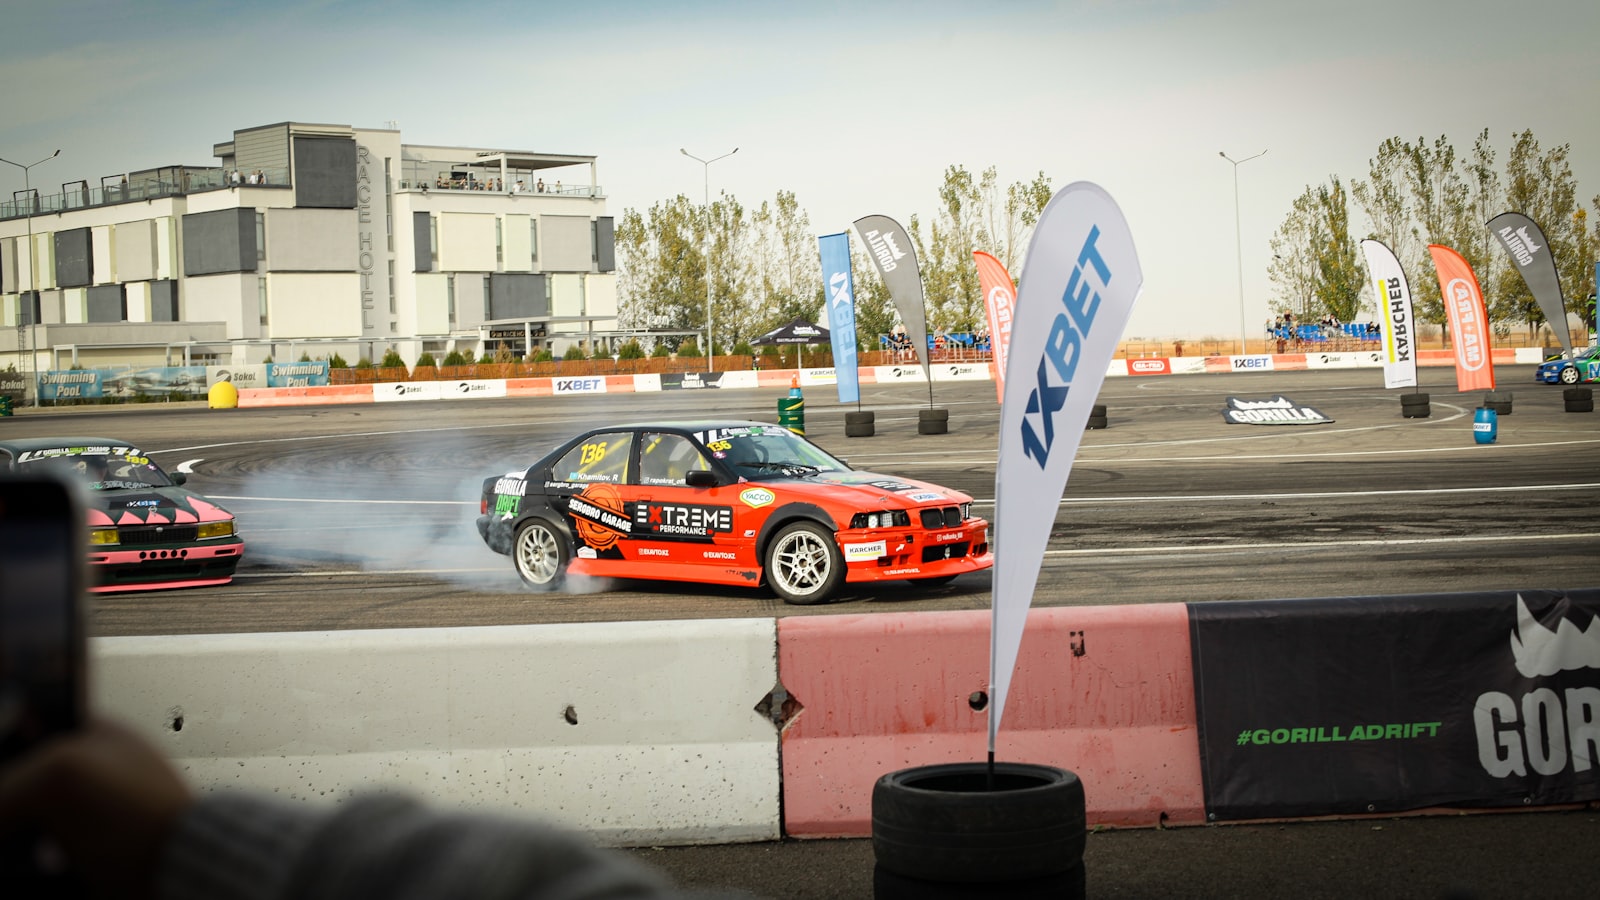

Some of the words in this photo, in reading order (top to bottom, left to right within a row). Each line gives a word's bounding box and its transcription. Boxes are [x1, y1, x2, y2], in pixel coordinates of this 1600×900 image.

[357, 145, 372, 224] RACE
[360, 231, 375, 330] HOTEL
[1020, 223, 1112, 472] 1XBET
[271, 364, 324, 376] Swimming
[1234, 358, 1268, 368] 1XBET
[41, 371, 96, 384] Swimming
[556, 379, 600, 391] 1XBET
[1229, 407, 1324, 422] GORILLA
[579, 441, 608, 466] 136
[706, 440, 732, 452] 136
[494, 478, 528, 497] GORILLA
[496, 495, 521, 513] DRIFT
[745, 492, 771, 502] YACCO
[600, 511, 633, 533] GARAGE
[636, 503, 731, 529] EXTREME
[659, 525, 707, 536] PERFORMANCE
[1236, 721, 1442, 746] #GORILLADRIFT
